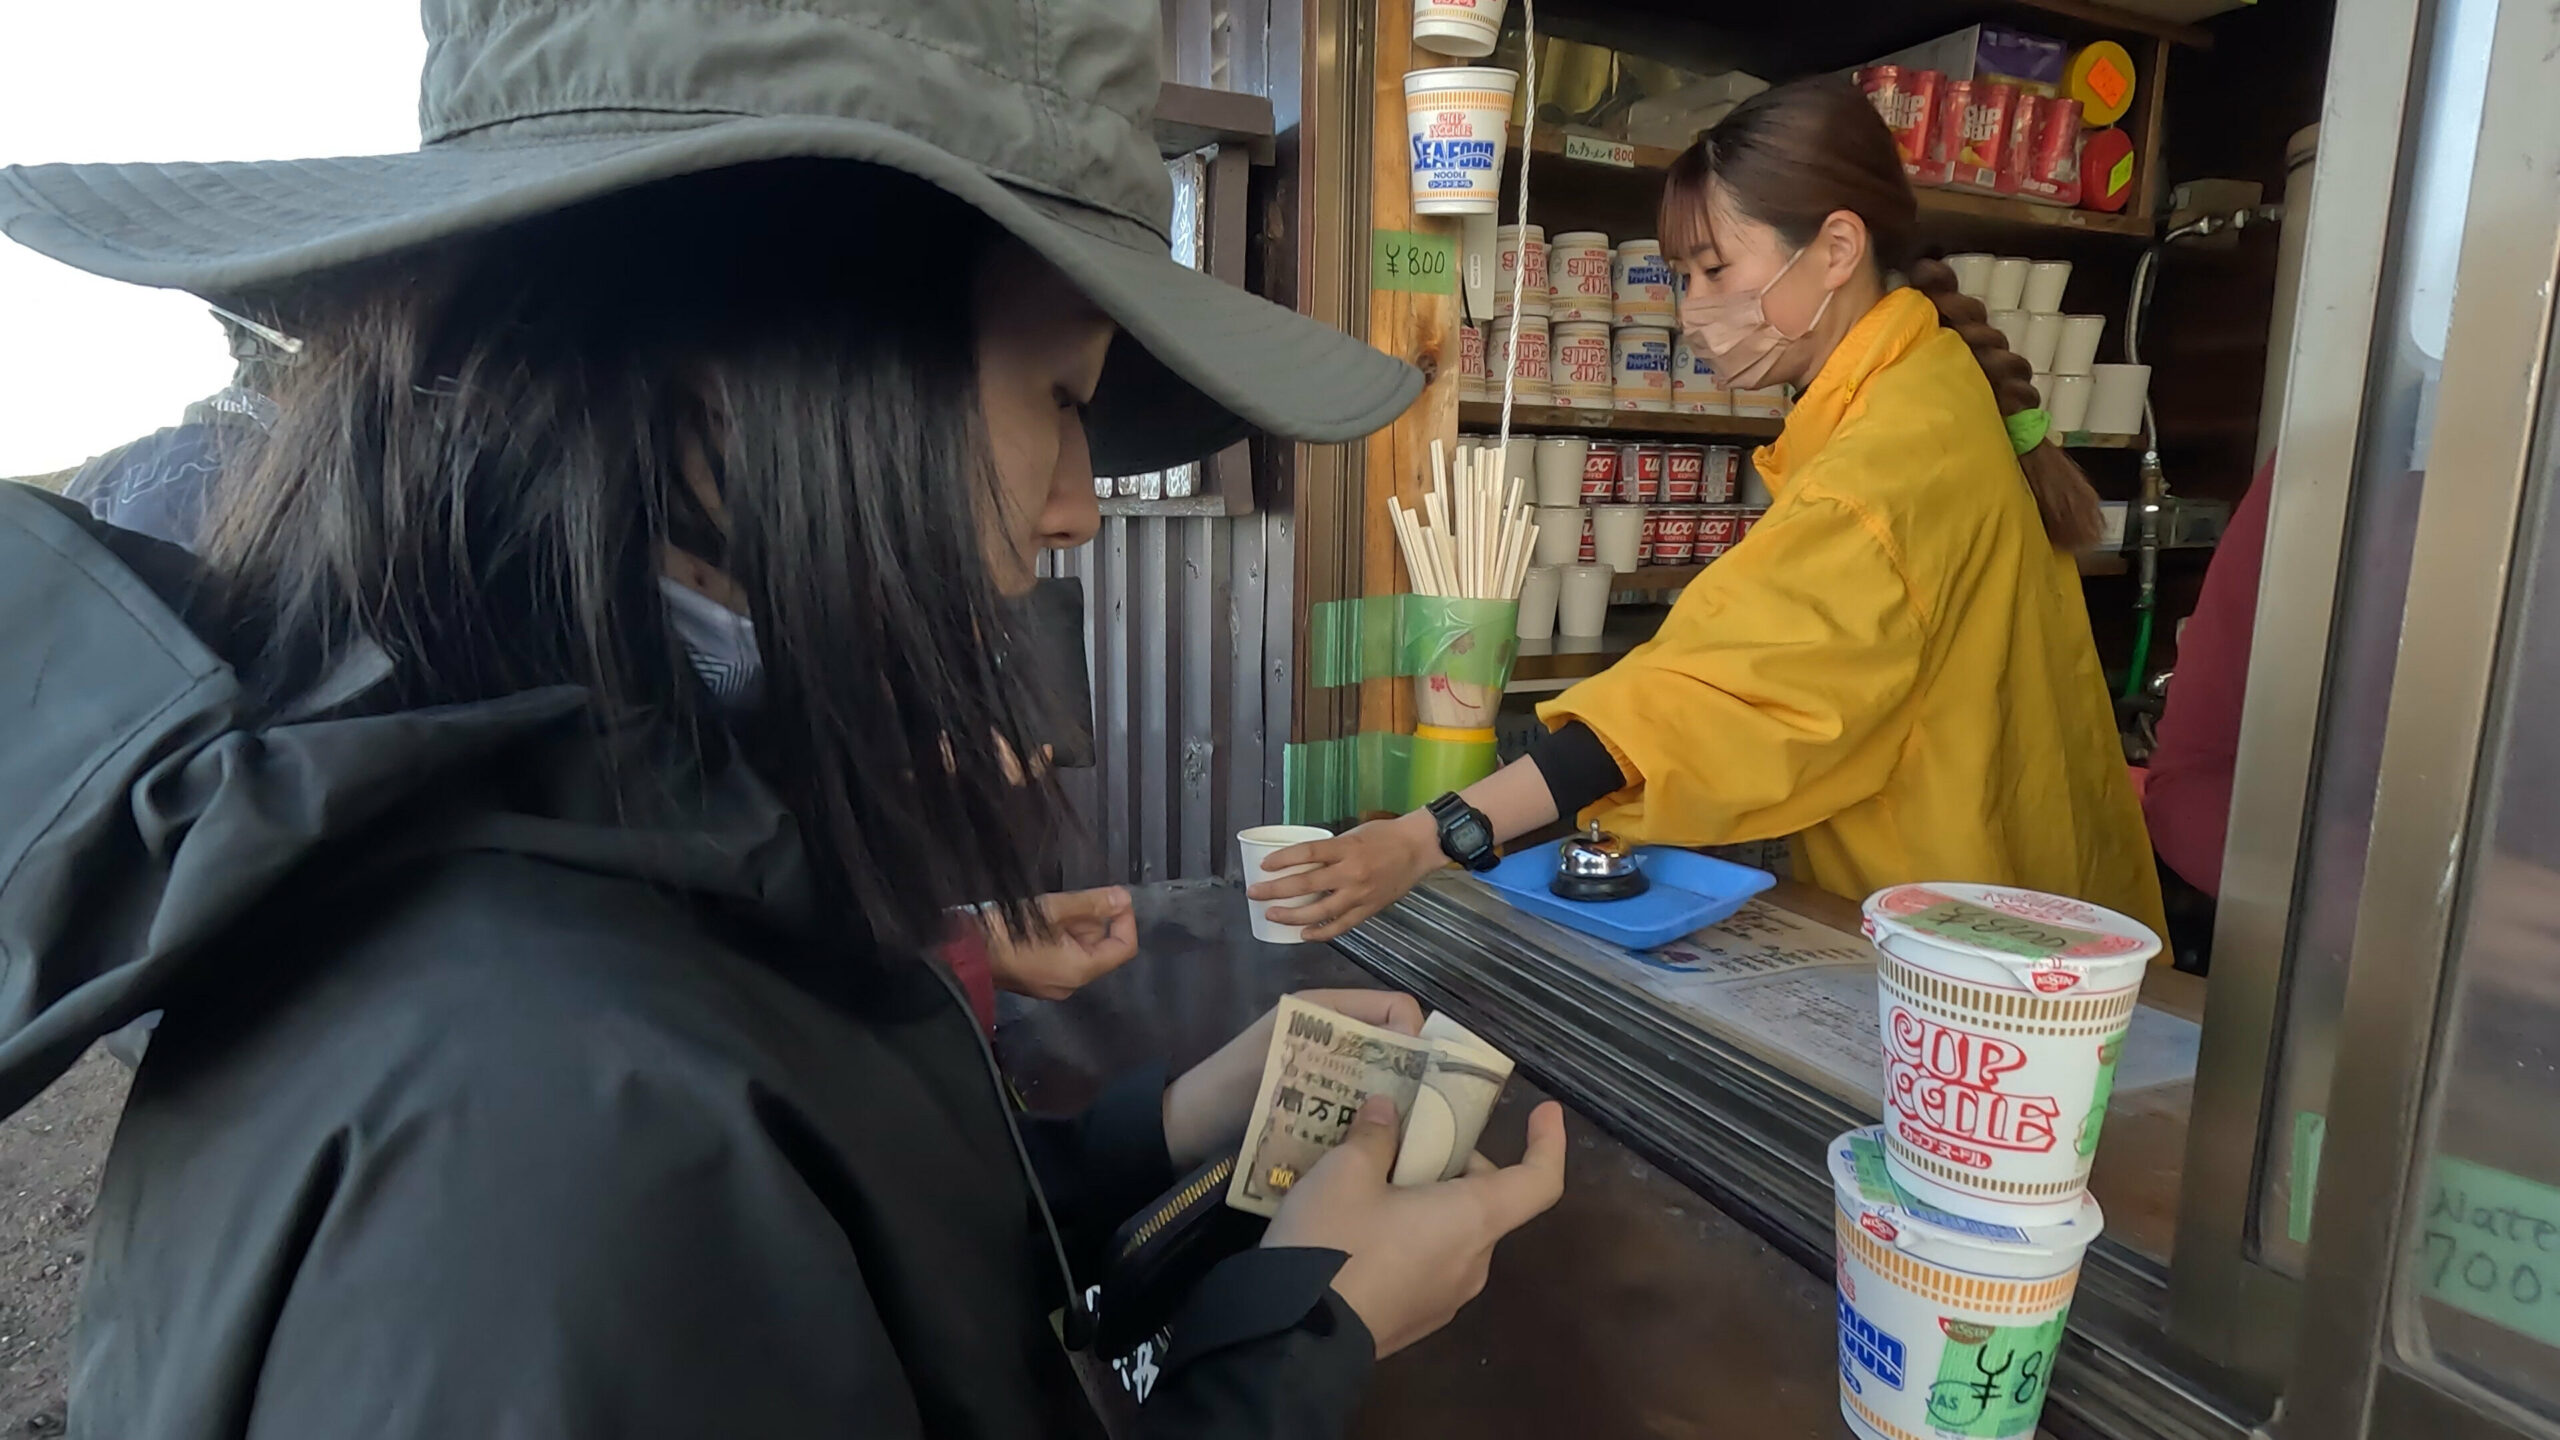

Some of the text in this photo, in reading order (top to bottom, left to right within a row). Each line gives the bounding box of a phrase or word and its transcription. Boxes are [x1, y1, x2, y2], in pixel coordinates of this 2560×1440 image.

[1412, 132, 1495, 172] SEAFOOD
[1433, 171, 1467, 179] NOODLE
[1385, 242, 1445, 278] ¥800
[1287, 1010, 1334, 1047] 10000
[1888, 1005, 2027, 1092] CUP
[1901, 1124, 1989, 1168] カップヌードル
